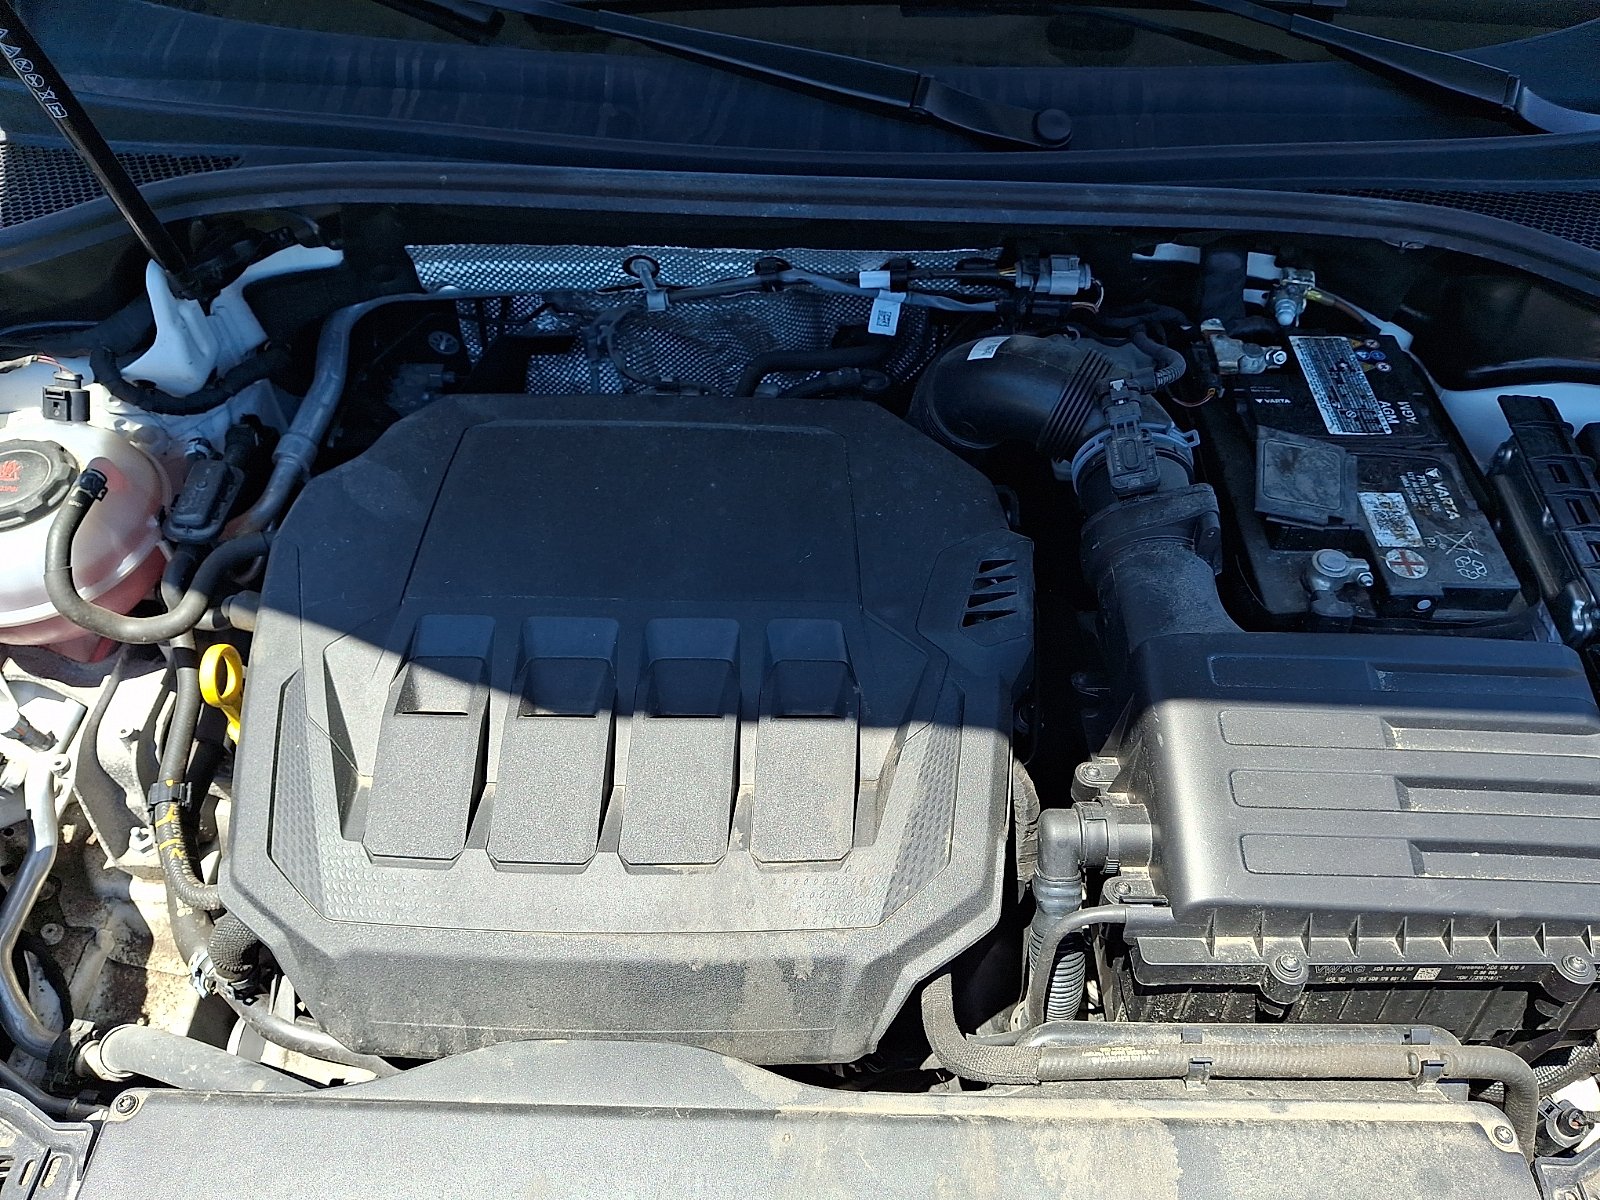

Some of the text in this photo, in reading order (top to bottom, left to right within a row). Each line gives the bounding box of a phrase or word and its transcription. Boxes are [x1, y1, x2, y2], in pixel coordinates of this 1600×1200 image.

[1378, 400, 1400, 424] AGM
[1397, 401, 1420, 425] AGM
[1433, 481, 1461, 520] VARTA
